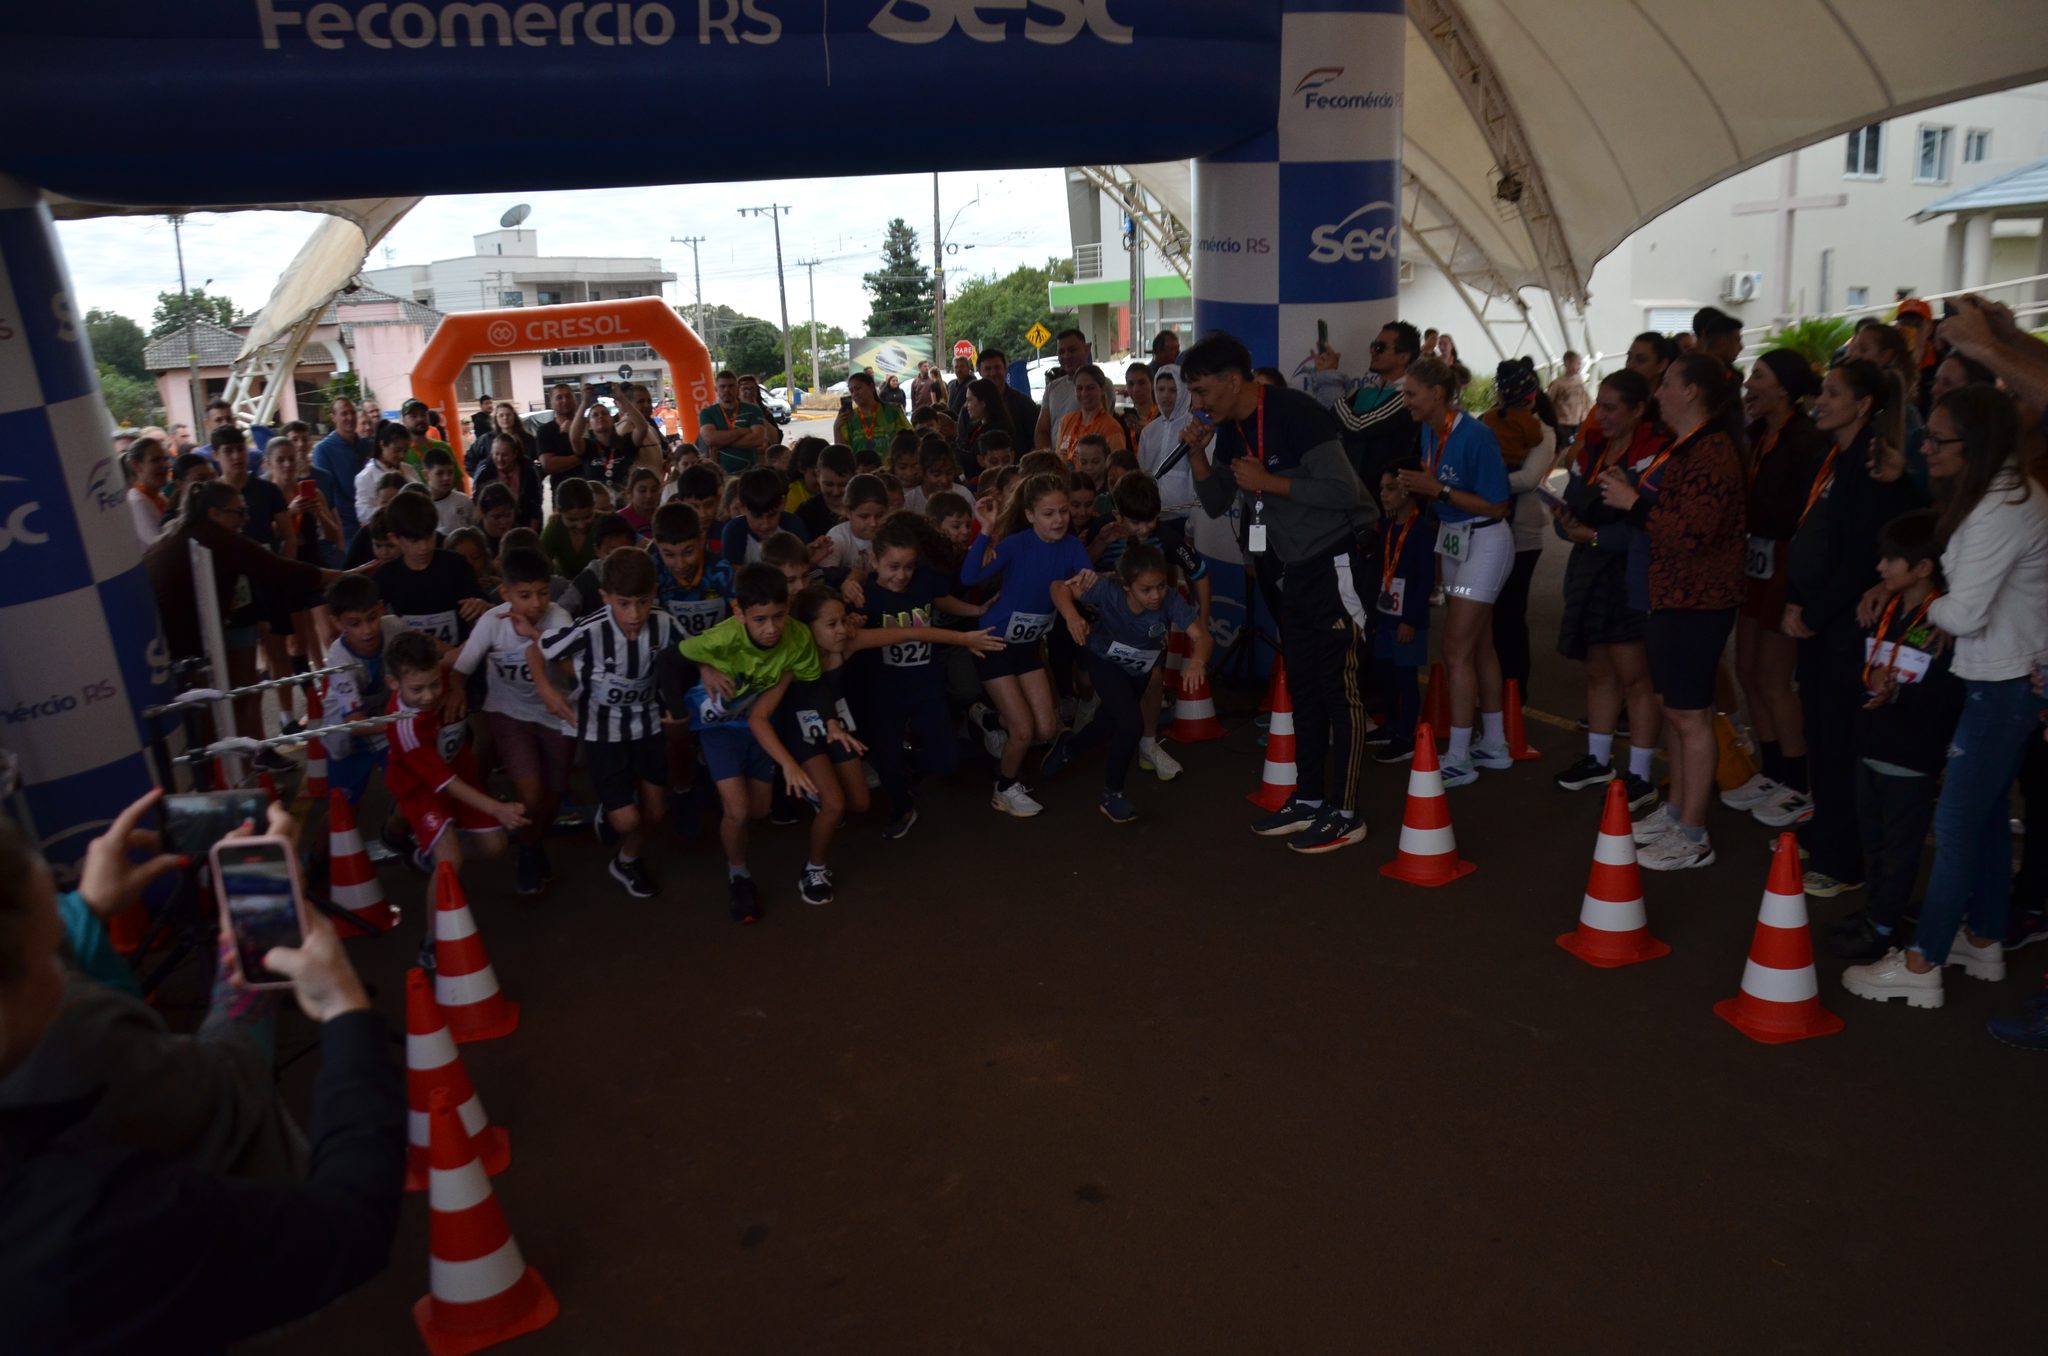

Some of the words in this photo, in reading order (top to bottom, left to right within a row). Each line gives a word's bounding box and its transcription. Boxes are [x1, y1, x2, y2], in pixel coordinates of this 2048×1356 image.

[698, 0, 783, 45] RS
[1246, 238, 1270, 254] RS
[525, 314, 630, 341] CRESOL
[955, 346, 972, 354] PARE
[1442, 532, 1460, 556] 48
[677, 611, 719, 633] 987
[889, 641, 930, 664] 922
